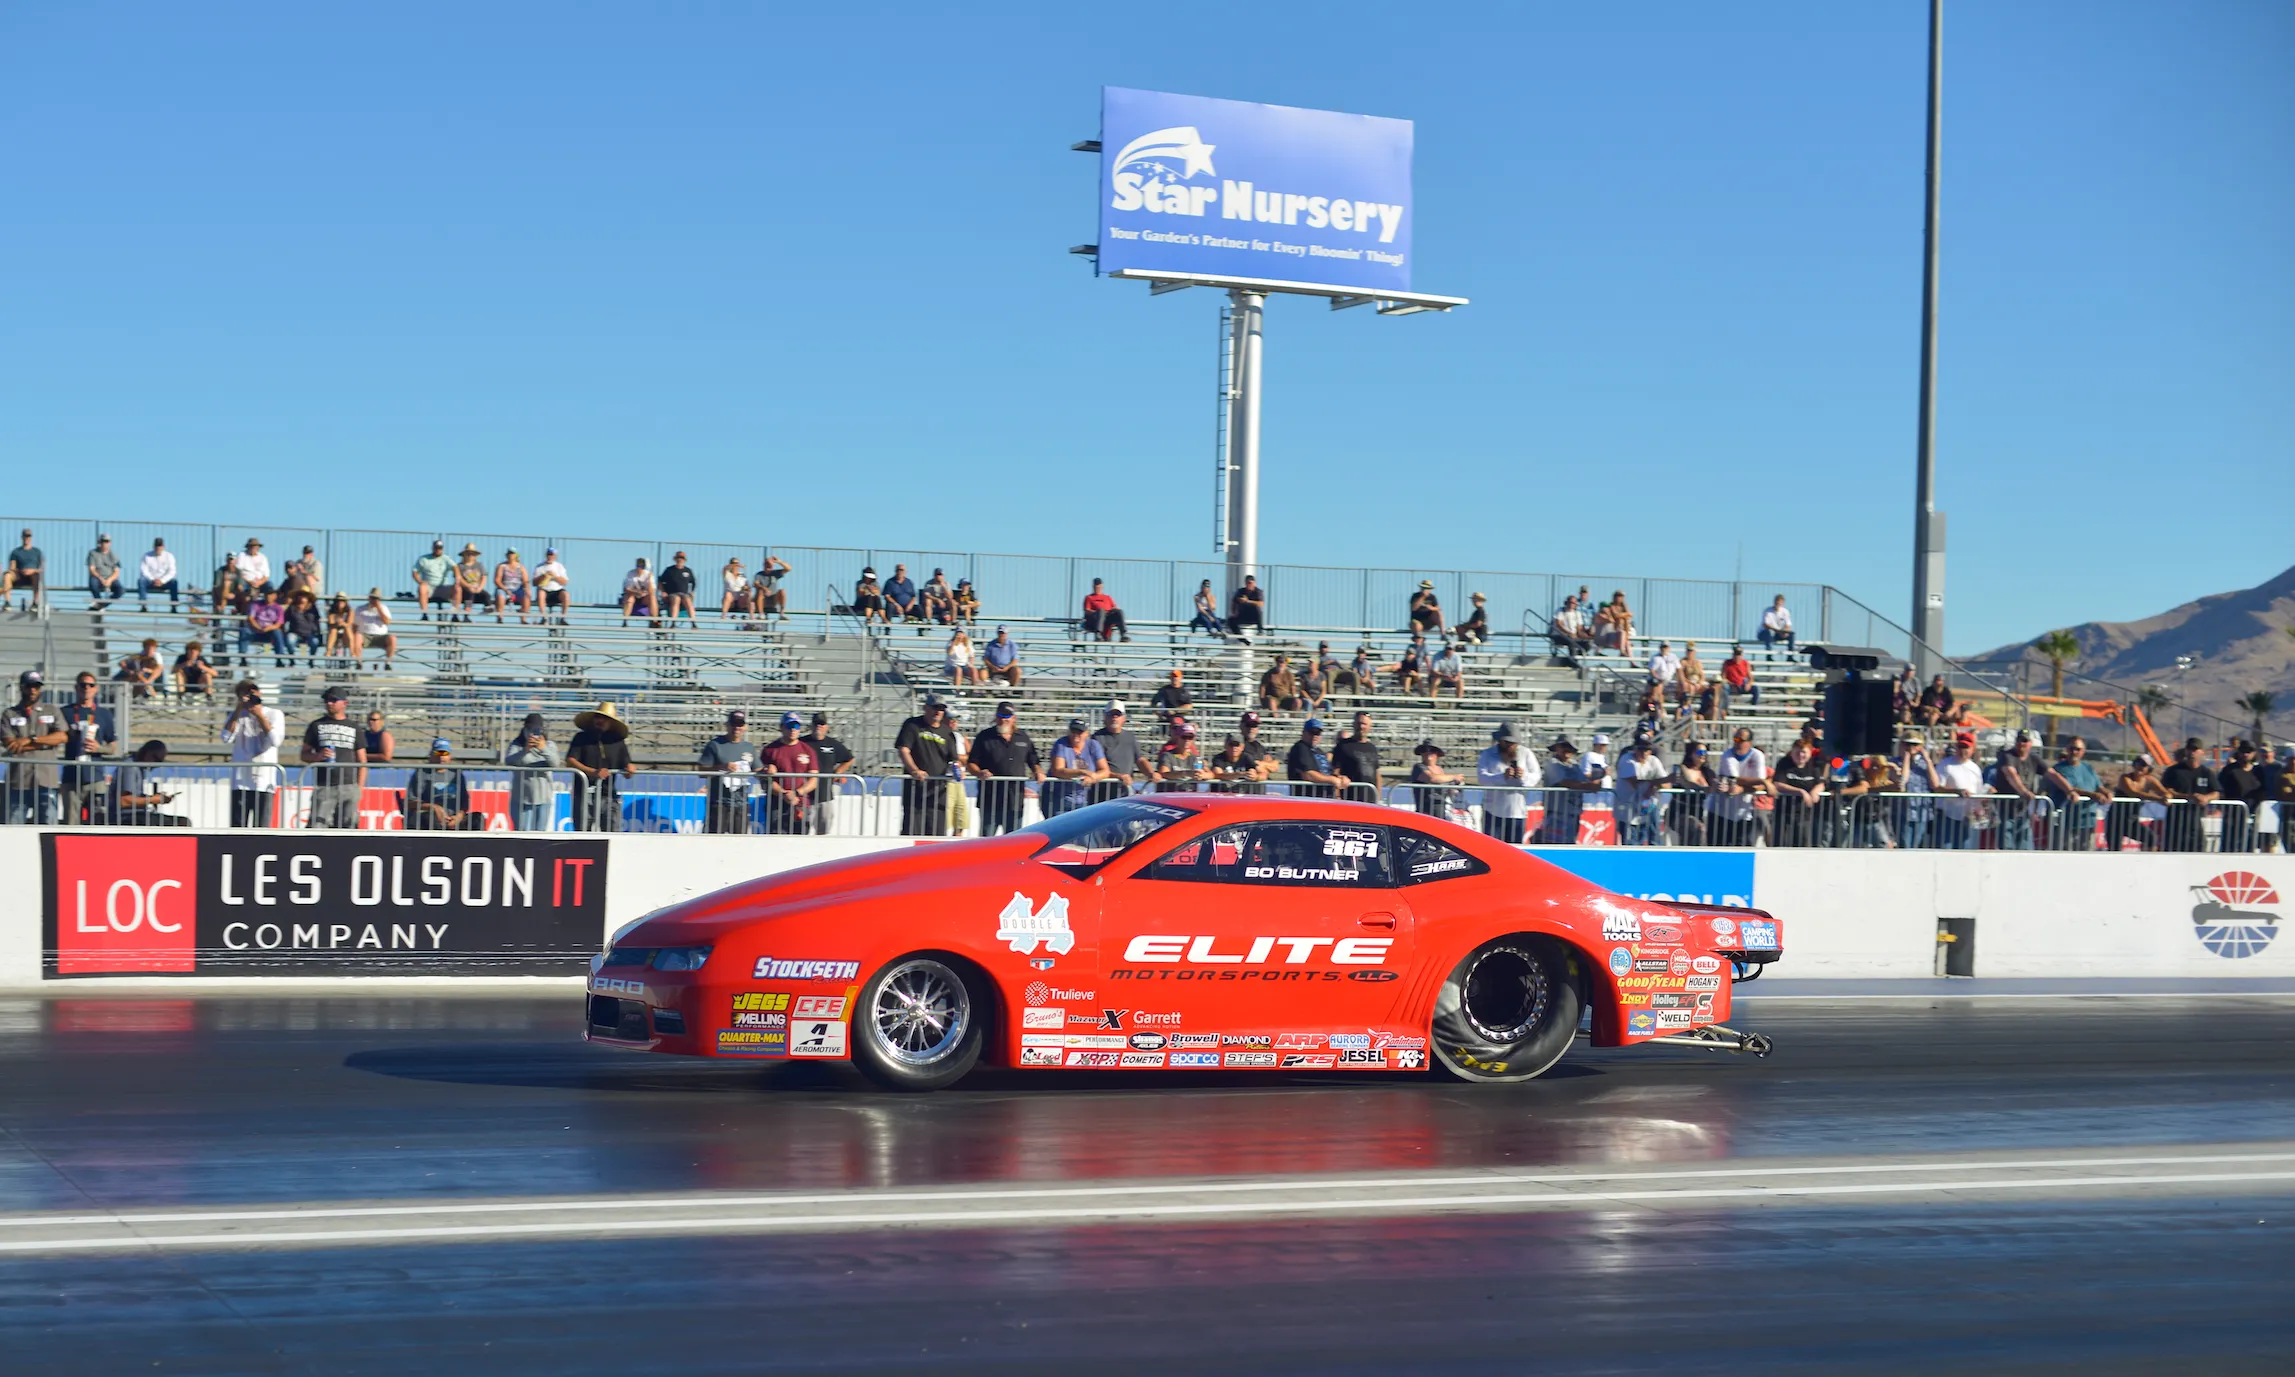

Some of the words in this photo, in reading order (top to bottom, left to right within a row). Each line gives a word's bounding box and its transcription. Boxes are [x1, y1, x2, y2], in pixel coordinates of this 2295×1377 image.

[1112, 172, 1218, 217] Star
[1222, 180, 1404, 243] Nursery
[1110, 227, 1140, 240] Your
[1142, 229, 1200, 245] Garden's
[1202, 235, 1249, 249] Partner
[1252, 239, 1271, 251] for
[1273, 241, 1307, 257] Every
[1309, 245, 1363, 260] Bloomin'
[1366, 250, 1404, 267] Thing!
[1330, 830, 1377, 841] PRO
[1323, 840, 1379, 857] 361
[1245, 867, 1274, 878] BO
[1278, 868, 1360, 881] BUTNER
[221, 854, 321, 905] LES
[350, 856, 534, 907] OLSON
[553, 858, 594, 907] IT
[77, 879, 182, 933] LOC
[1003, 918, 1052, 930] DOUBLE
[1061, 918, 1067, 930] A
[222, 922, 450, 950] COMPANY
[1603, 932, 1642, 941] TOOLS
[1742, 927, 1775, 937] CAMPING
[1744, 935, 1776, 946] WORLD
[1124, 935, 1394, 964] ELITE
[754, 957, 860, 979] STOCKSETH
[1354, 972, 1392, 981] LLC
[1688, 977, 1719, 987] HOGAN'S
[1050, 988, 1095, 1001] Trulieve
[1652, 994, 1680, 1007] Holley
[732, 993, 791, 1010] JEGS
[798, 999, 843, 1013] CFE
[736, 1013, 786, 1025] MELLING
[1025, 1010, 1064, 1025] Bruno's
[1133, 1010, 1181, 1024] Garrett
[1664, 1014, 1690, 1022] WELD
[719, 1031, 785, 1043] QUARTER-MAX
[1171, 1034, 1219, 1043] Browell
[1222, 1036, 1271, 1044] DIAMOND
[1276, 1035, 1327, 1045] ARP
[1330, 1035, 1370, 1044] AURORA
[1075, 1053, 1111, 1065] XRP
[1122, 1055, 1164, 1065] COMETIC
[1170, 1053, 1219, 1065] sparco
[1227, 1053, 1274, 1062] STEF'S
[1339, 1050, 1386, 1062] JESEL
